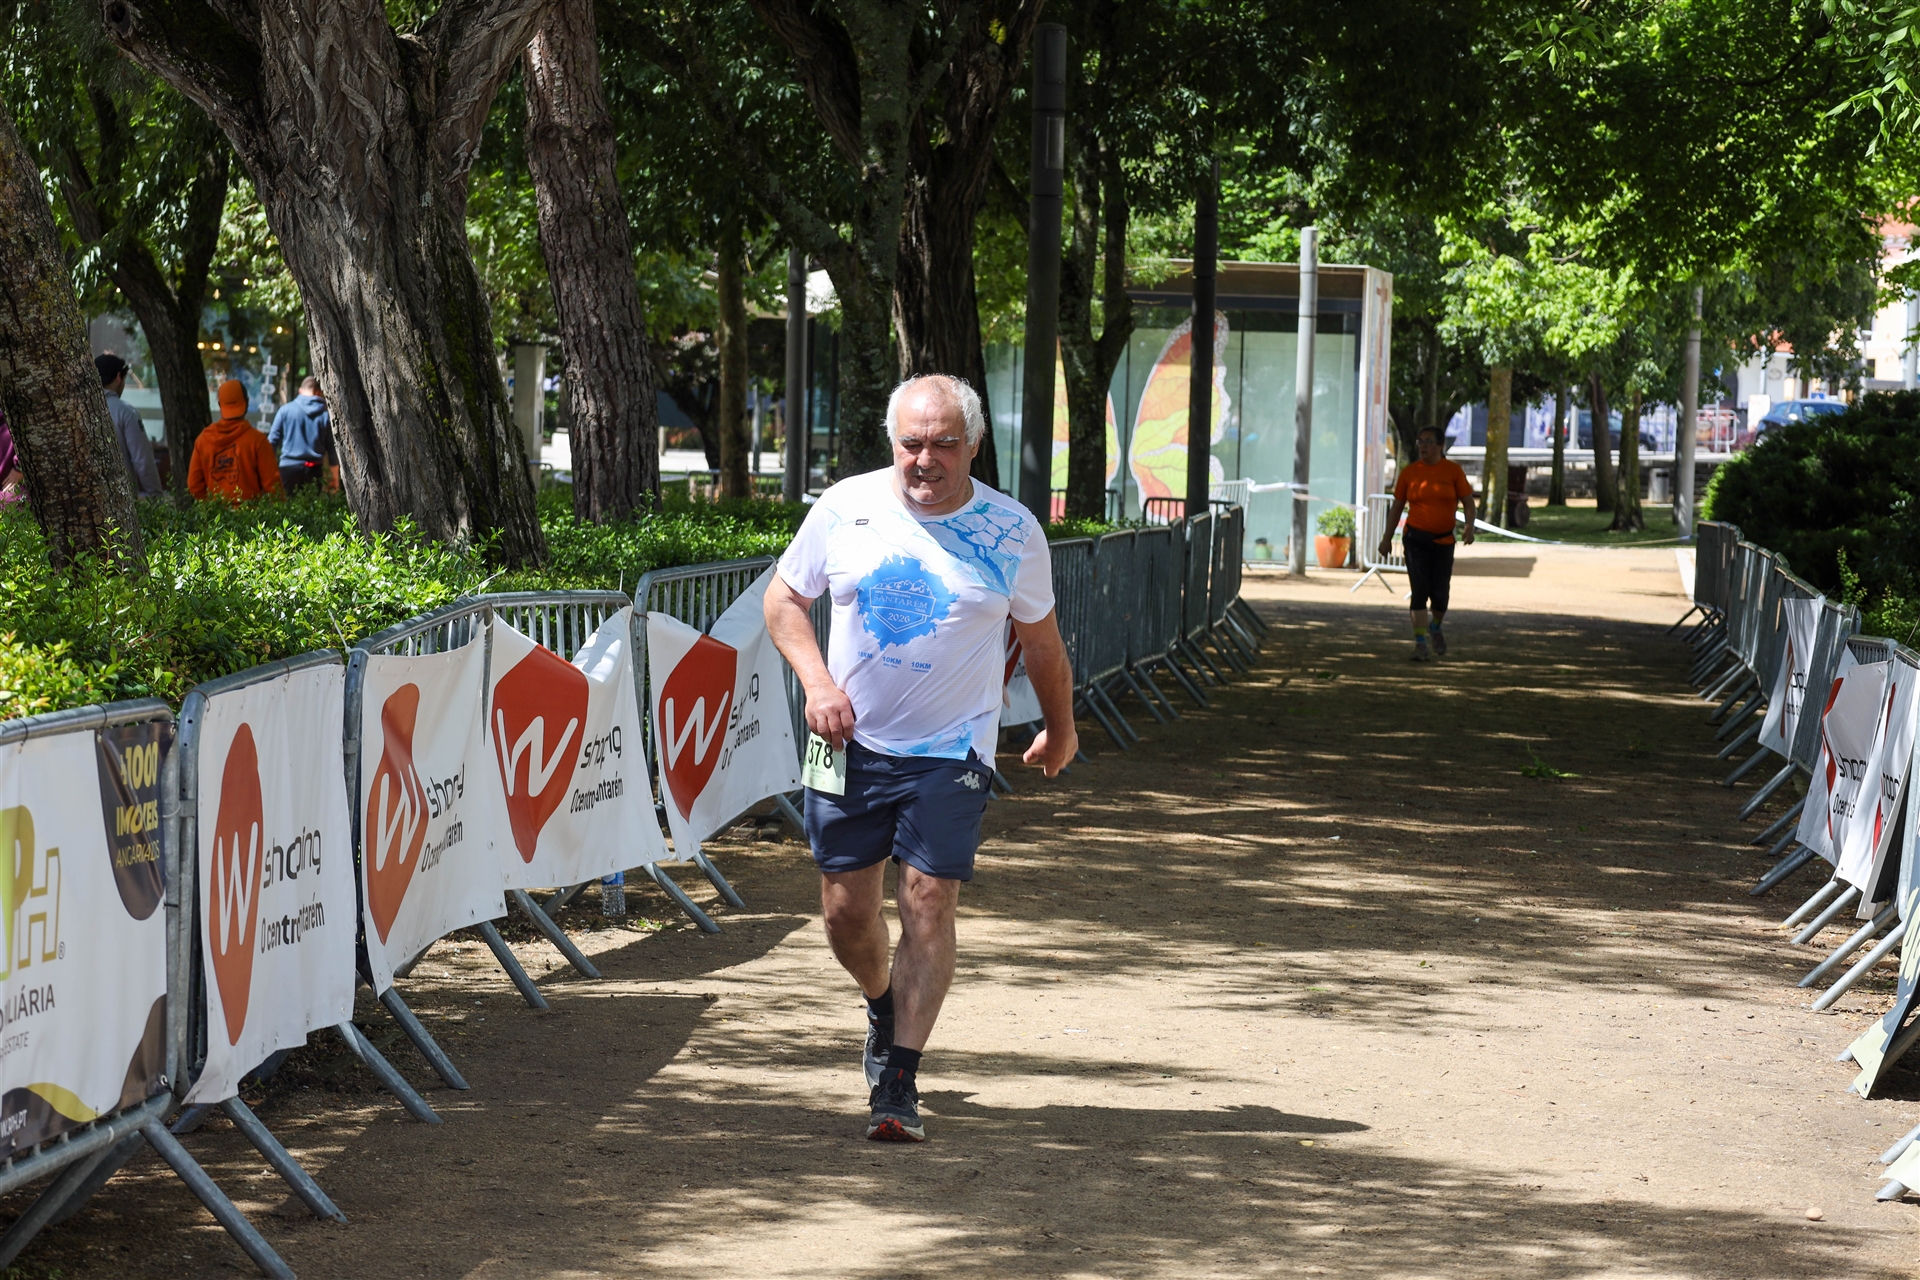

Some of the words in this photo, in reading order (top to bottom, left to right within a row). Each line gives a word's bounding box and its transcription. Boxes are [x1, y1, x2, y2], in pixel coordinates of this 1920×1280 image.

[874, 593, 928, 609] SANTARÉM
[887, 612, 911, 623] 2026
[882, 656, 902, 665] 10KM
[911, 661, 932, 669] 10KM
[808, 738, 834, 769] 378
